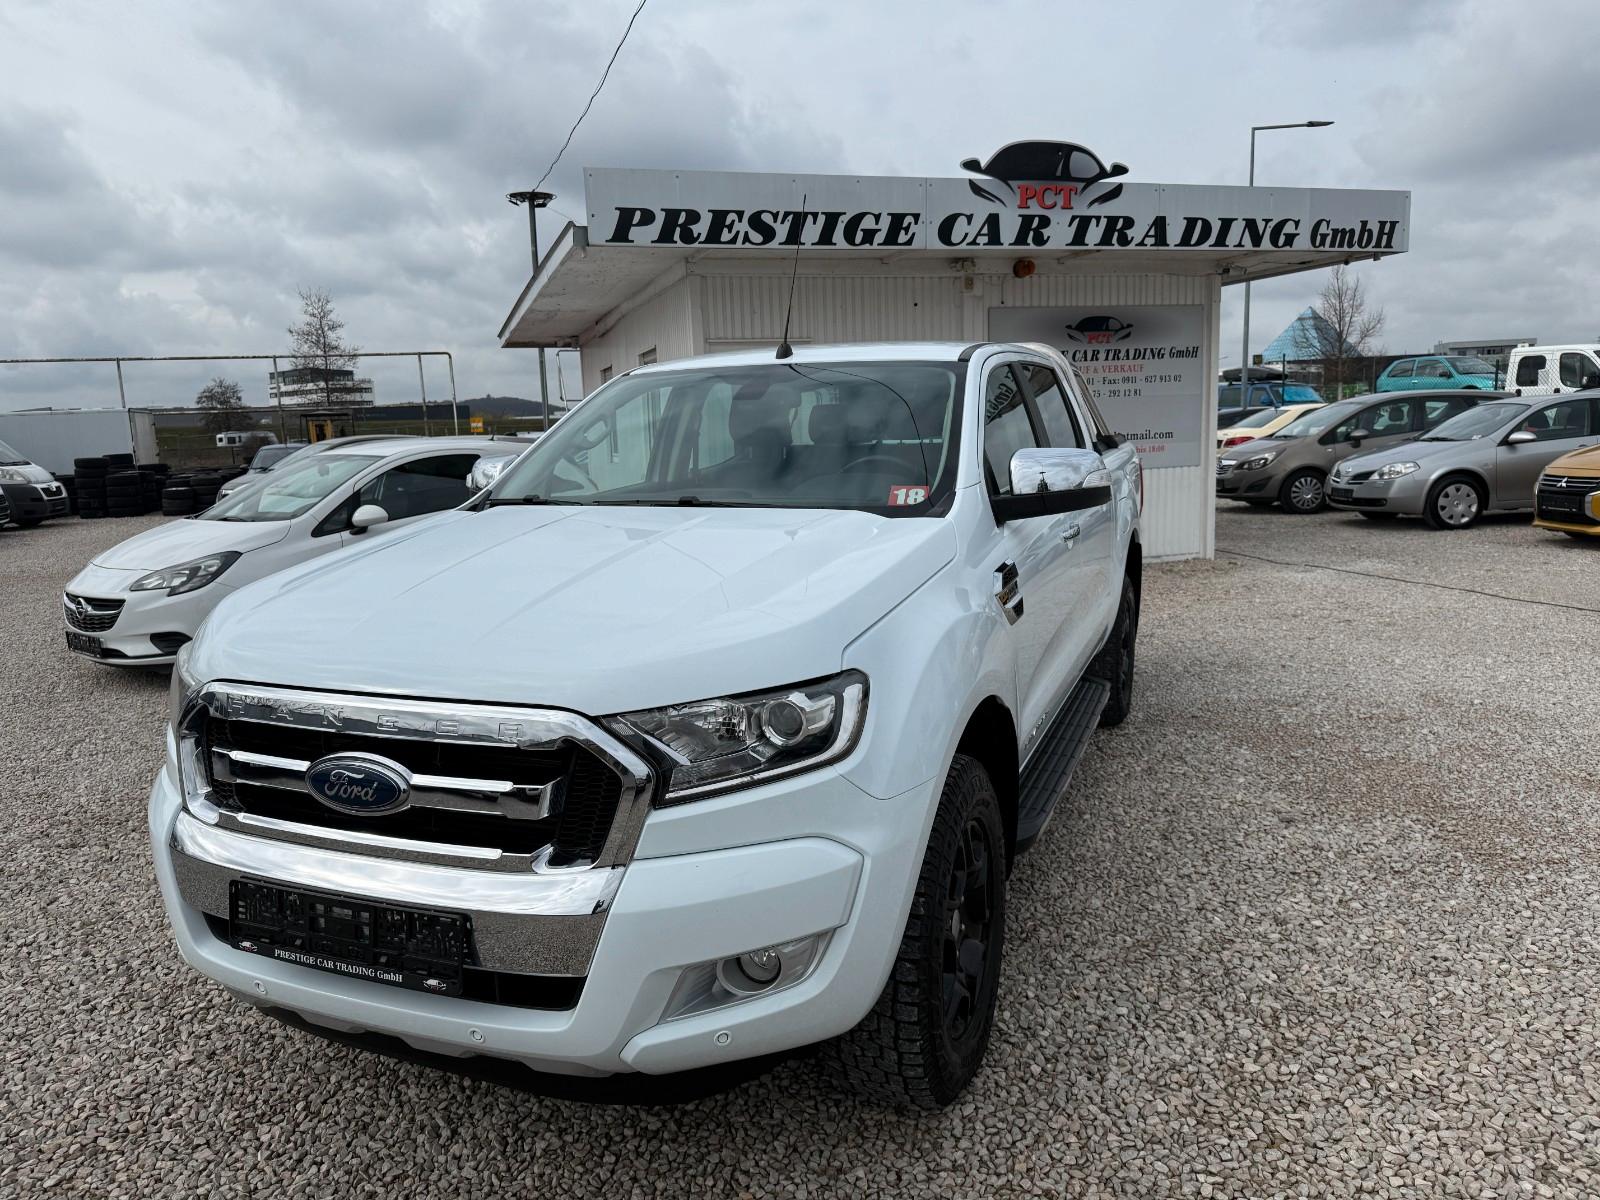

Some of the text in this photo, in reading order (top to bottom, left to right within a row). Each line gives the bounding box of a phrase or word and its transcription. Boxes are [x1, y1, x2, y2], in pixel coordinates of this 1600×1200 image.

[1016, 184, 1078, 210] PCT
[605, 206, 1400, 249] PRESTIGE CAR TRADING GmbH
[1087, 332, 1114, 345] PCT
[1071, 349, 1100, 362] CAR
[1103, 347, 1166, 361] TRADING
[1168, 346, 1200, 359] GmbH
[1101, 364, 1145, 374] VERKAUF
[1102, 376, 1120, 385] Fax:
[1121, 375, 1138, 385] 0911
[1144, 374, 1158, 383] 627
[1159, 374, 1172, 383] 913
[1173, 373, 1183, 382] 02
[1108, 389, 1121, 398] 292
[1133, 388, 1142, 397] 81
[893, 488, 926, 505] 18
[324, 769, 379, 802] Ford
[274, 949, 316, 965] PRESTIGE
[317, 957, 334, 969] CAR
[335, 961, 376, 978] TRADING
[376, 969, 403, 983] GmbH
